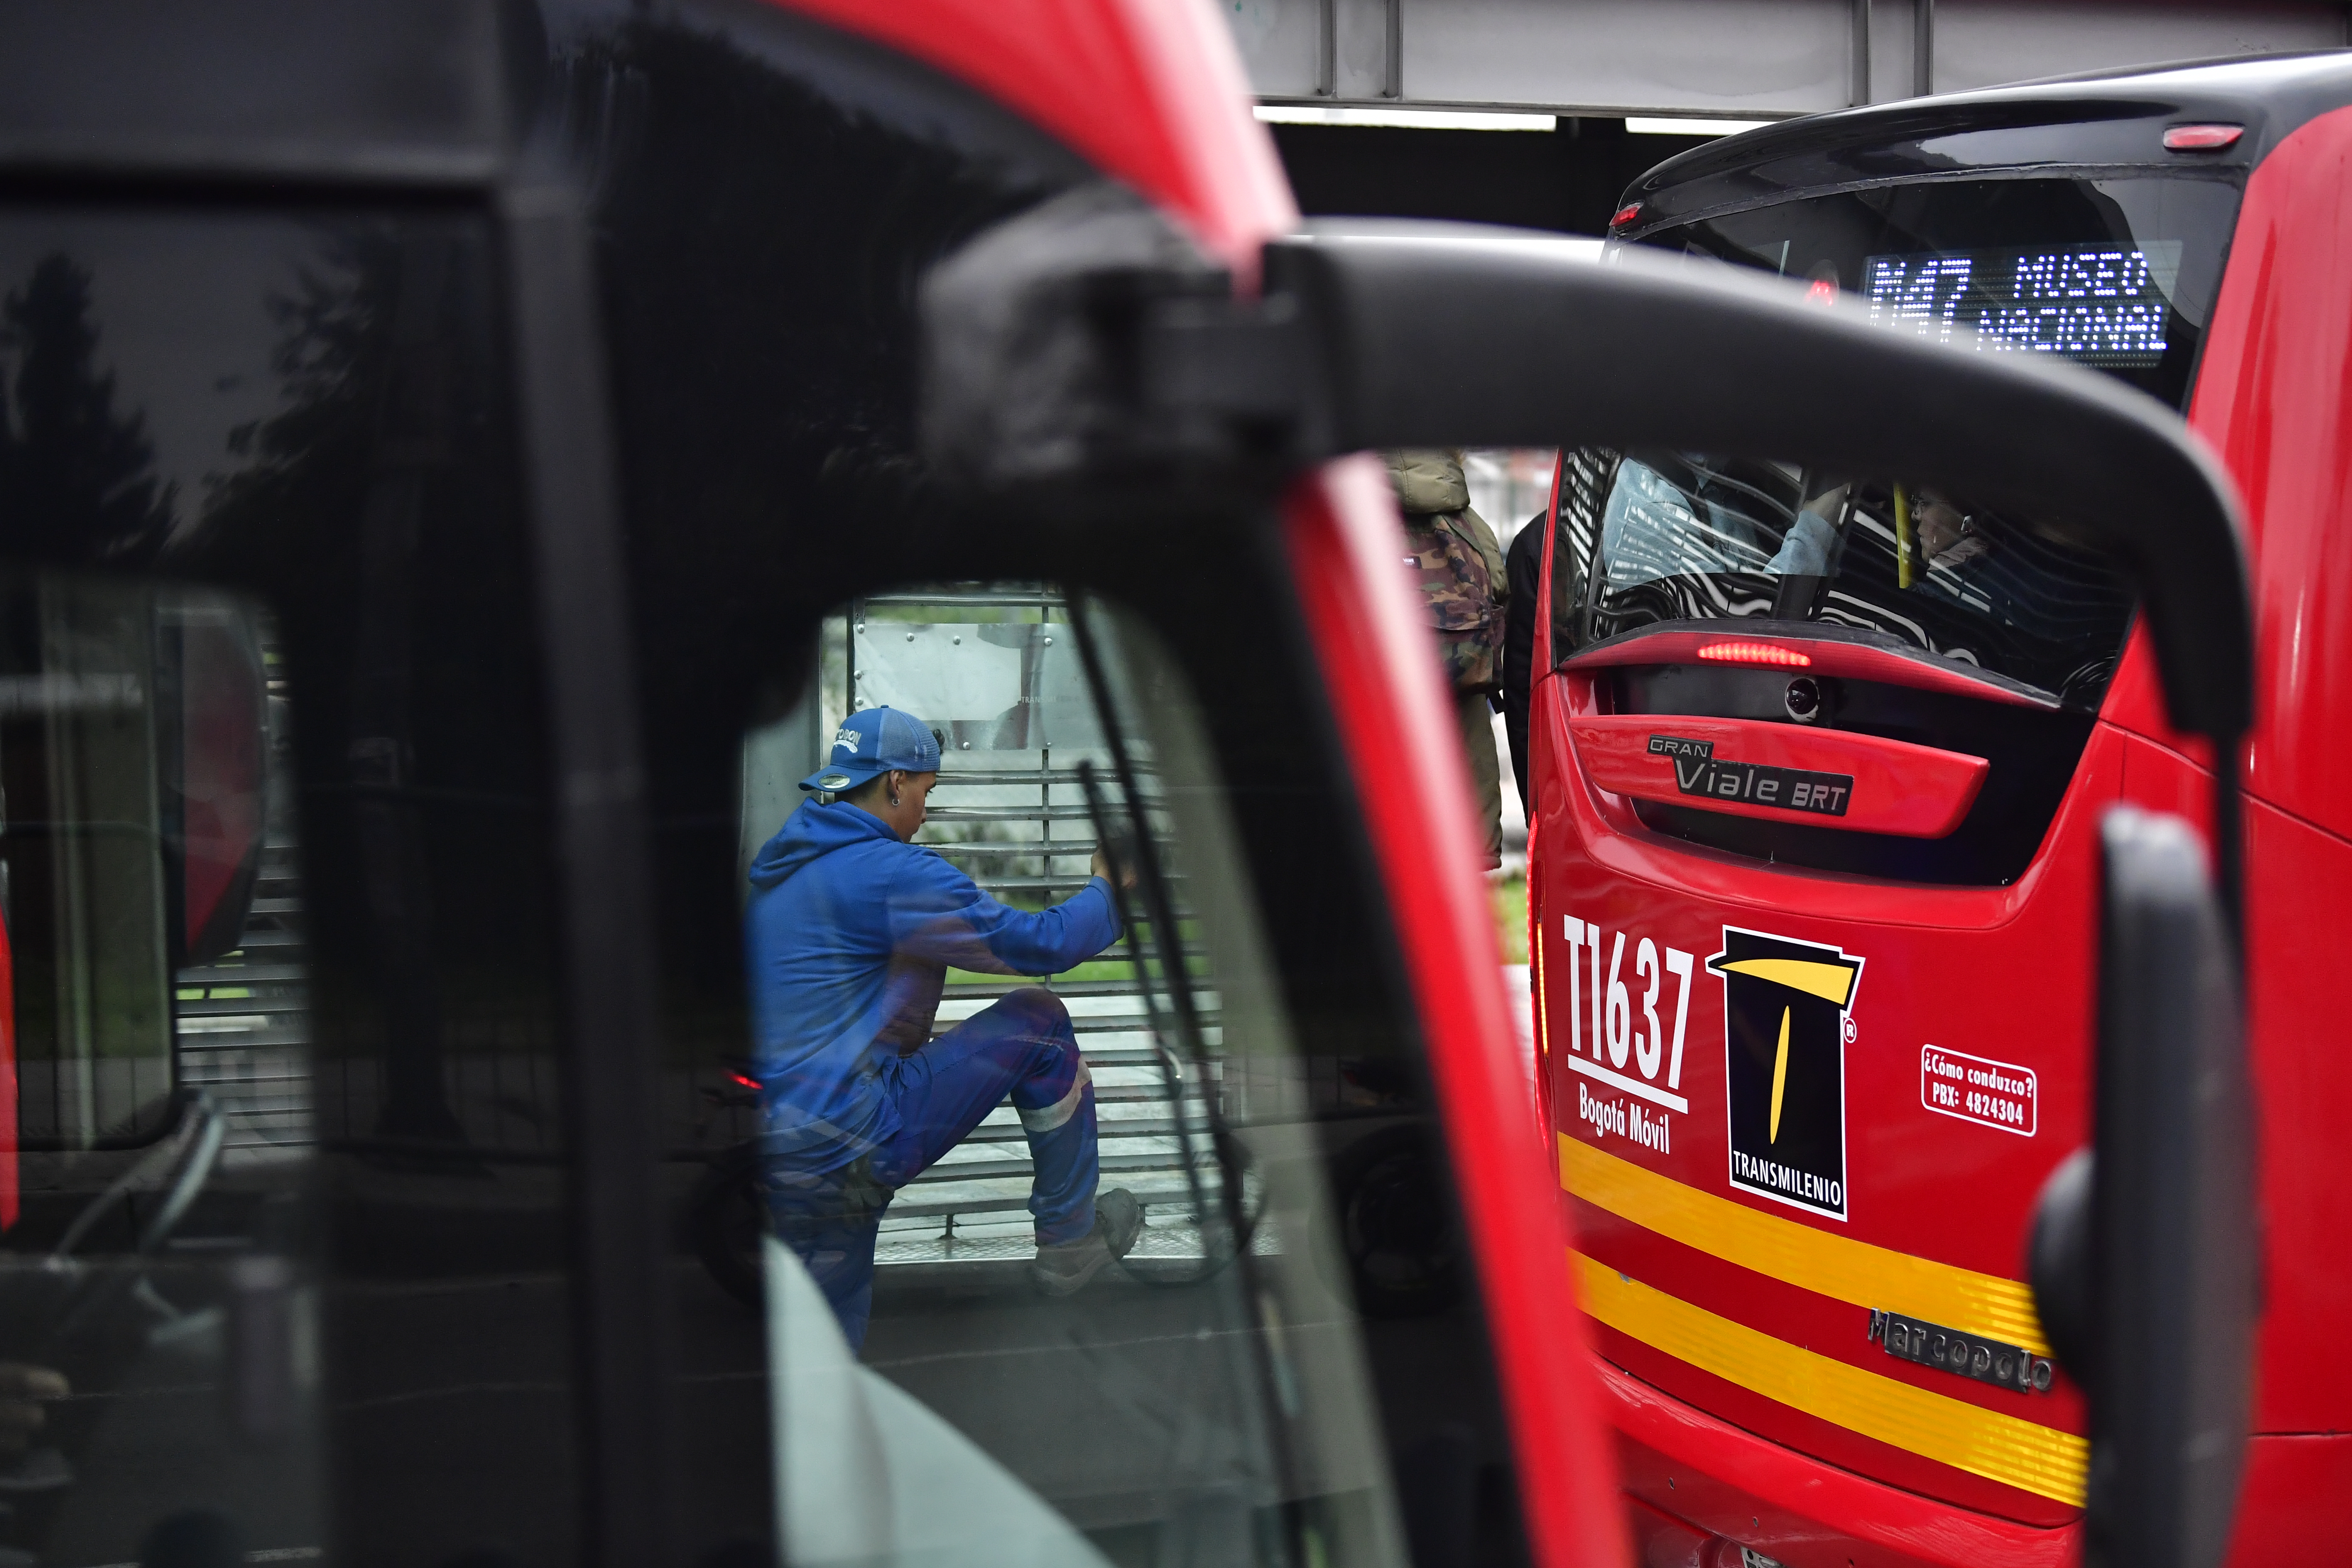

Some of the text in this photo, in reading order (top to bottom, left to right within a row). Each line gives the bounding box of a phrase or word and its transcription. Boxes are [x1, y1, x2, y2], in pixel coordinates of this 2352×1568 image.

[2014, 252, 2147, 297] MUSEO
[1976, 305, 2167, 351] NACIONAL
[1650, 739, 1708, 757] GRAN
[1675, 759, 1846, 810] Viale BRT
[1564, 914, 1694, 1090] T1637
[1925, 1052, 2033, 1098] ¿Cómo conduzco?
[1579, 1082, 1670, 1154] Bogotá Móvil
[1933, 1081, 2023, 1125] PBX: 4824304
[1733, 1150, 1841, 1206] TRANSMILENIO
[1868, 1307, 2052, 1391] Marcopolo
